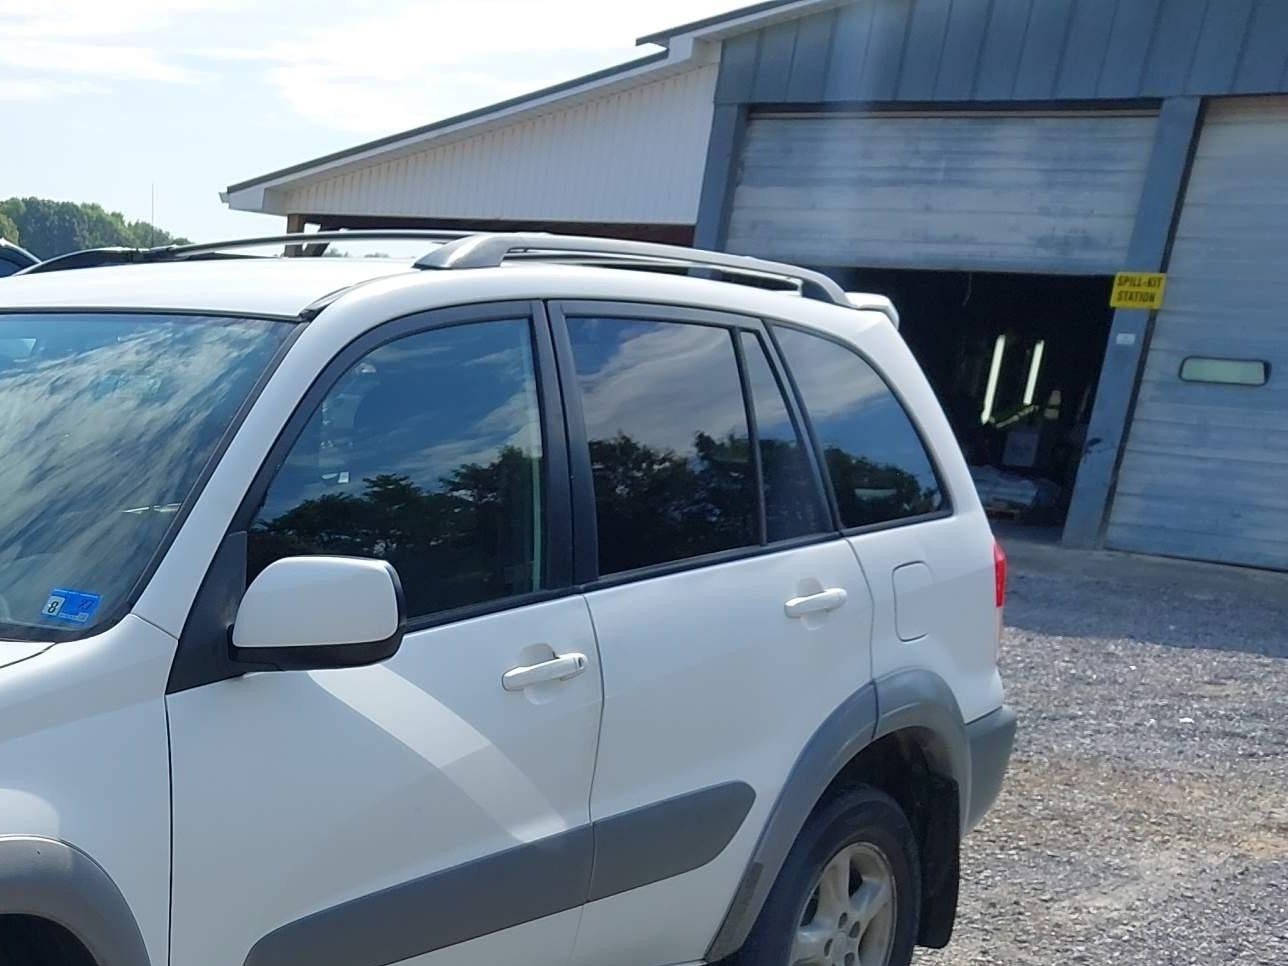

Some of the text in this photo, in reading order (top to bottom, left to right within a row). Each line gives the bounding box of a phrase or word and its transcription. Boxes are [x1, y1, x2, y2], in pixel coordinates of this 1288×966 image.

[1117, 275, 1163, 288] SPILL-KIT
[1117, 290, 1155, 303] STATION
[47, 600, 59, 614] 8
